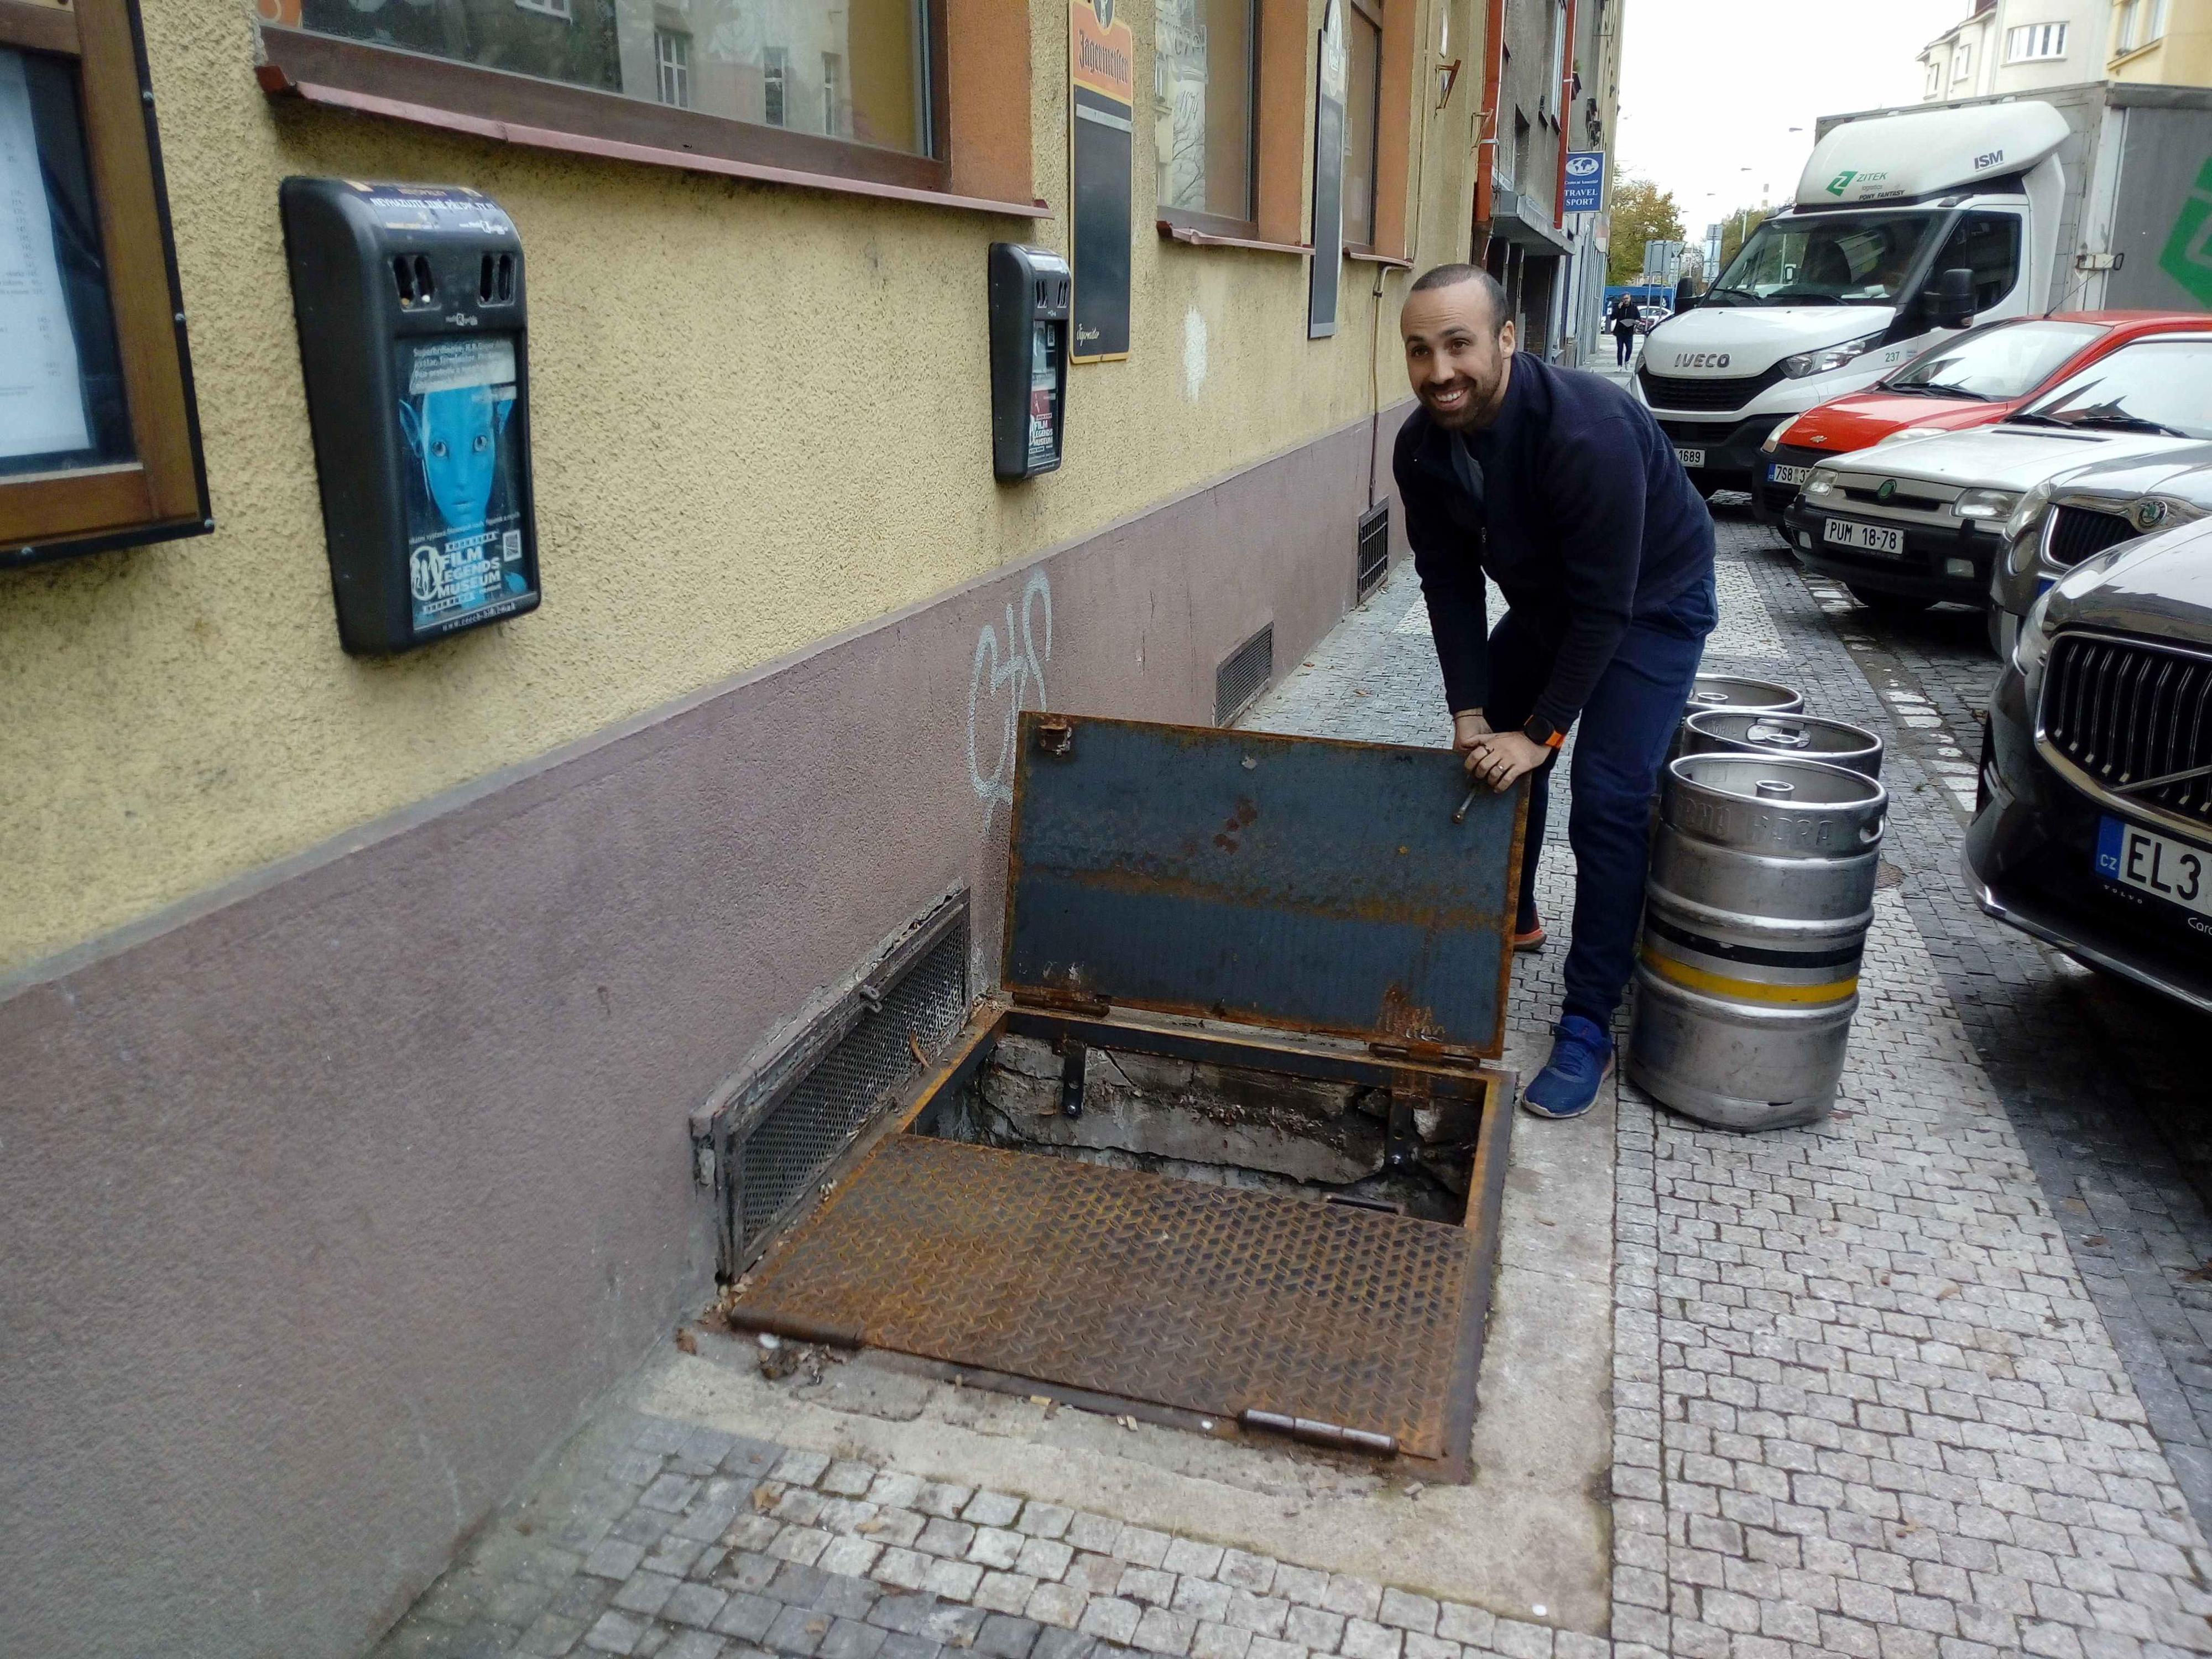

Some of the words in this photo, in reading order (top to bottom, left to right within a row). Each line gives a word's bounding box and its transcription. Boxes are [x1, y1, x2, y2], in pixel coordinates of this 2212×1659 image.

[1974, 149, 2003, 169] ISM
[1566, 198, 1594, 206] SPORT
[1674, 353, 1731, 368] IVECO
[1885, 351, 1900, 363] 237
[1678, 450, 1701, 463] 1689
[1776, 466, 1793, 482] 7S8
[1829, 521, 1853, 542] PUM
[1862, 527, 1897, 550] 18-78
[441, 545, 483, 571] FILM
[437, 570, 502, 599] MUSEUM
[2100, 853, 2117, 871] CZ
[2104, 885, 2143, 904] VOLVO
